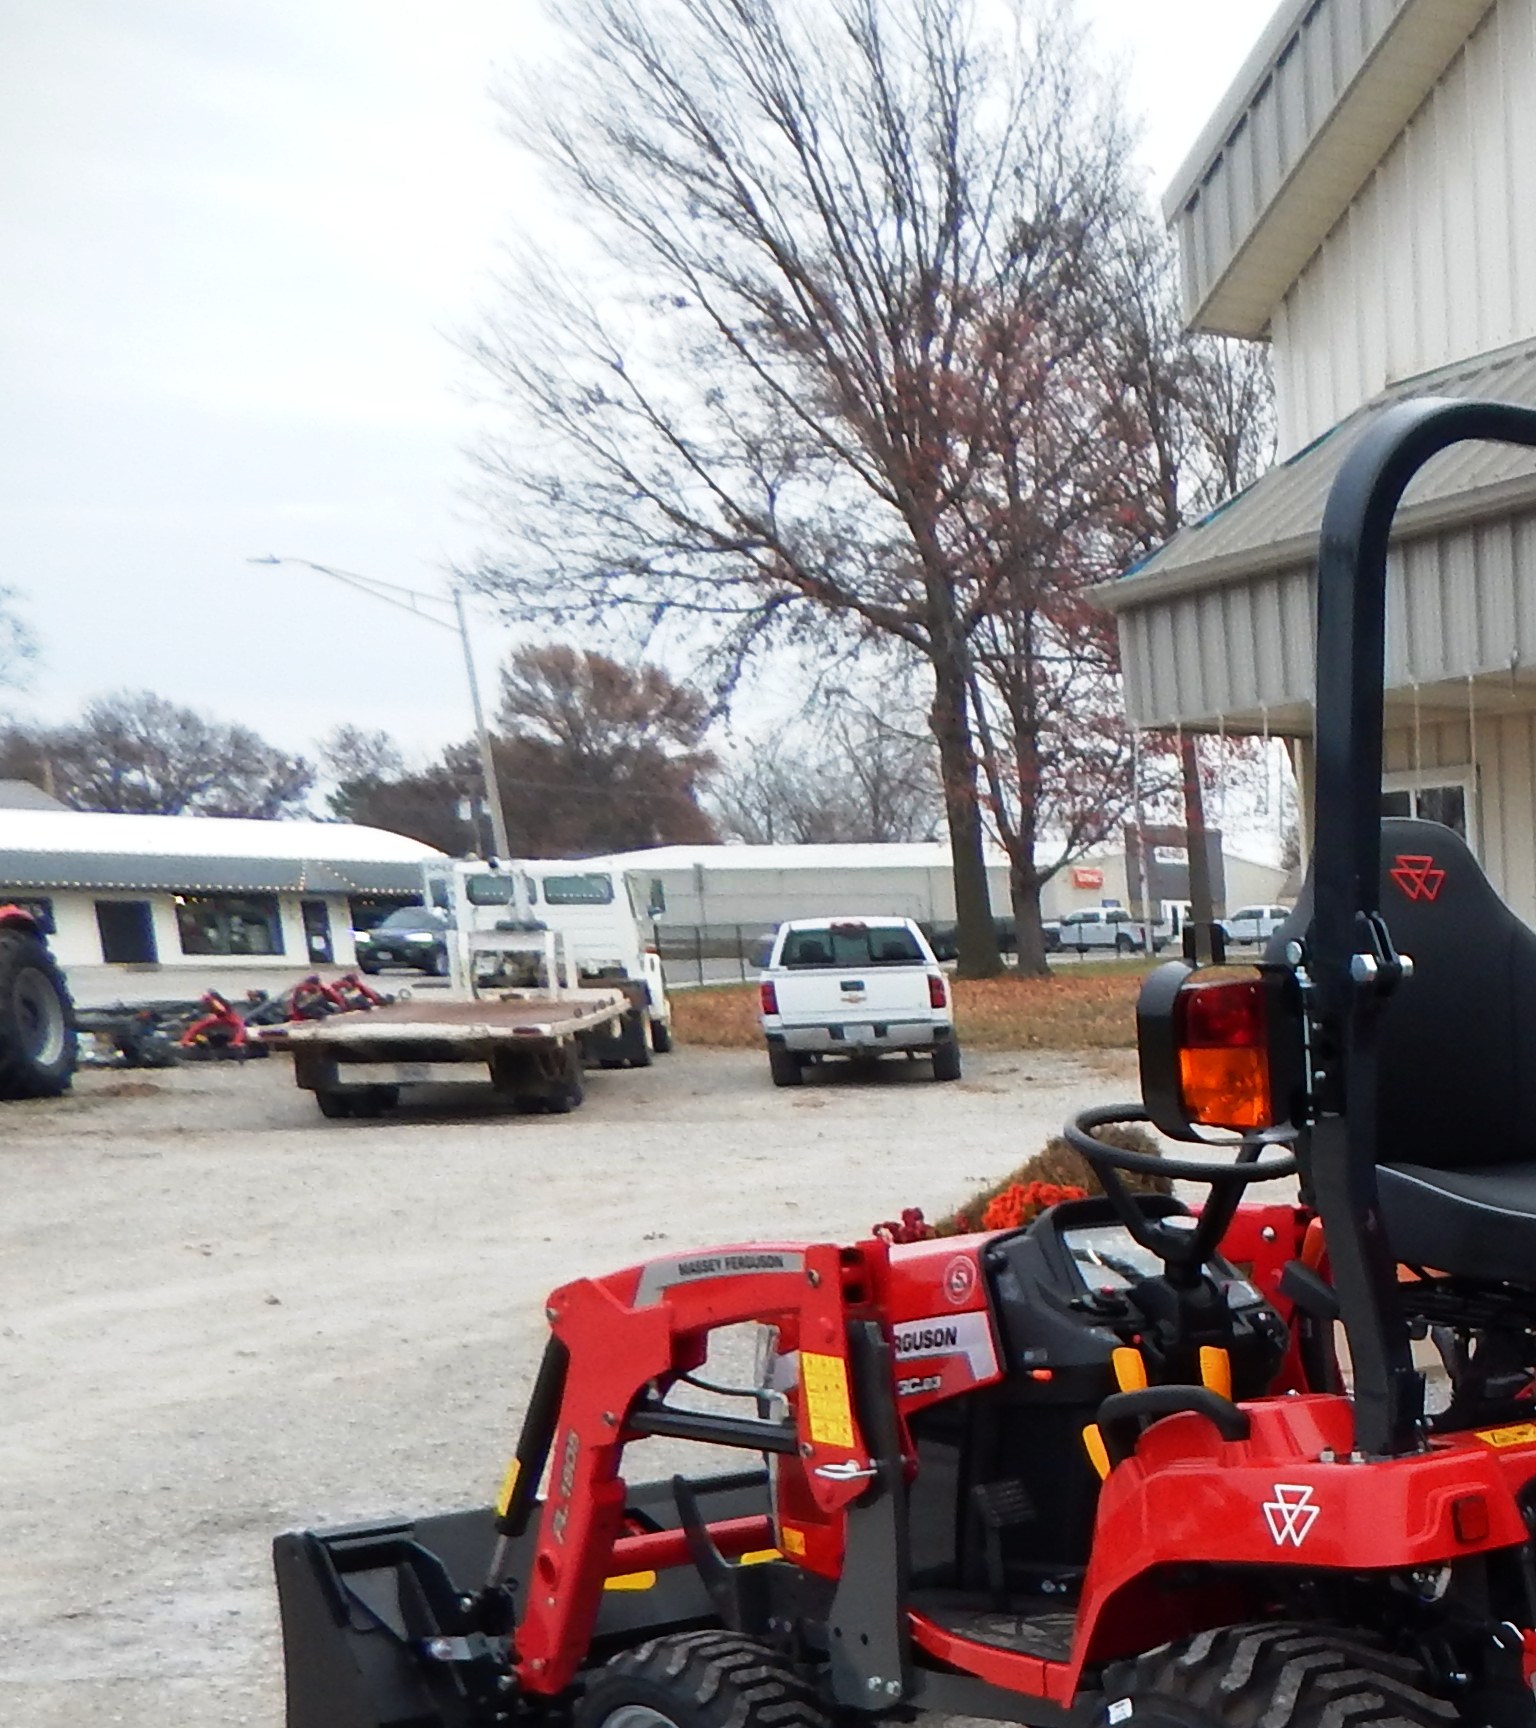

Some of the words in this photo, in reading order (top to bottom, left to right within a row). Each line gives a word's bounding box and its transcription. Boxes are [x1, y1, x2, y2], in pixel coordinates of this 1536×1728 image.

[678, 1259, 721, 1276] MASSEY
[725, 1255, 784, 1270] FERGUSON
[895, 1326, 958, 1353] RGUSON
